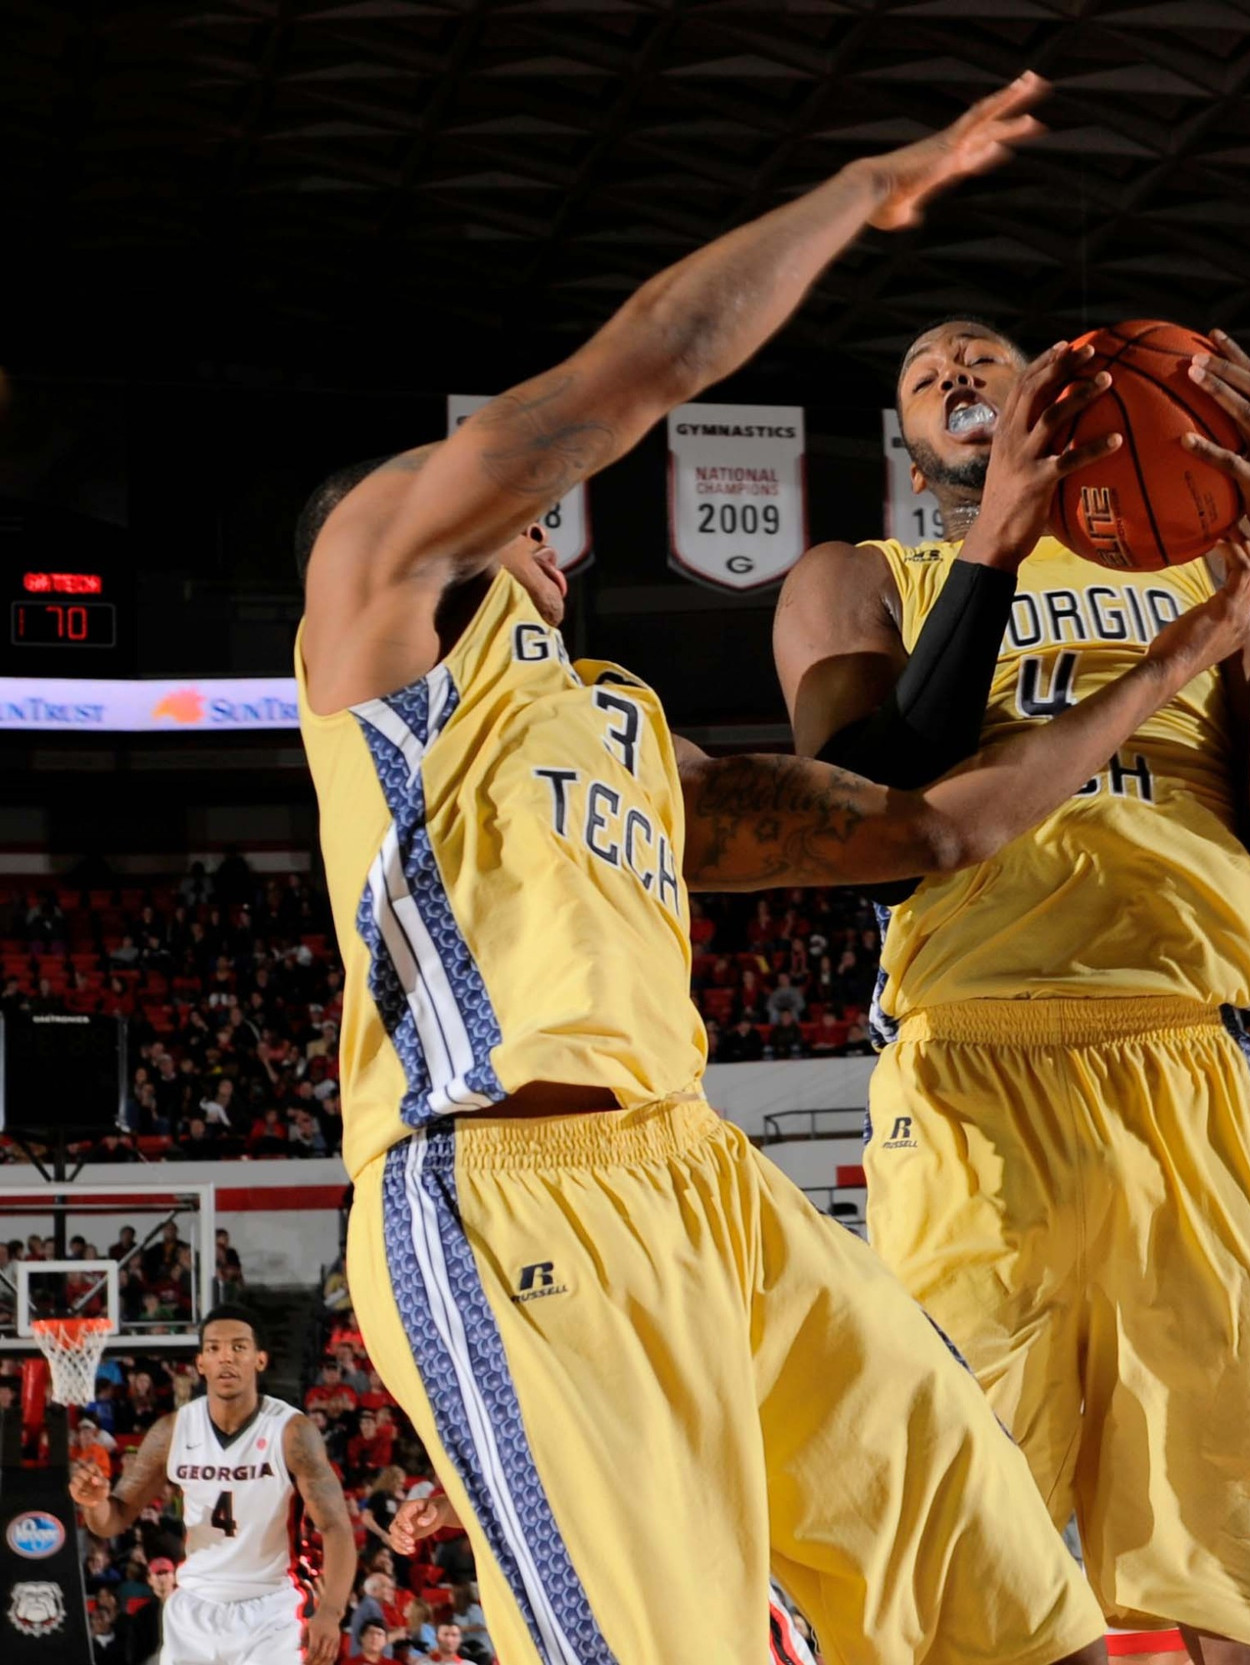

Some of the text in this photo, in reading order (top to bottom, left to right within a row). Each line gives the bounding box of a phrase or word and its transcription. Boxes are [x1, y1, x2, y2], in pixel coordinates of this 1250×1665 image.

[677, 423, 796, 438] GYMNASTICS
[695, 467, 778, 482] NATIONAL
[697, 482, 778, 496] CHAMPIONS
[698, 503, 780, 535] 2009
[725, 556, 754, 574] G
[176, 1461, 275, 1482] GEORGIA
[211, 1490, 238, 1538] 4
